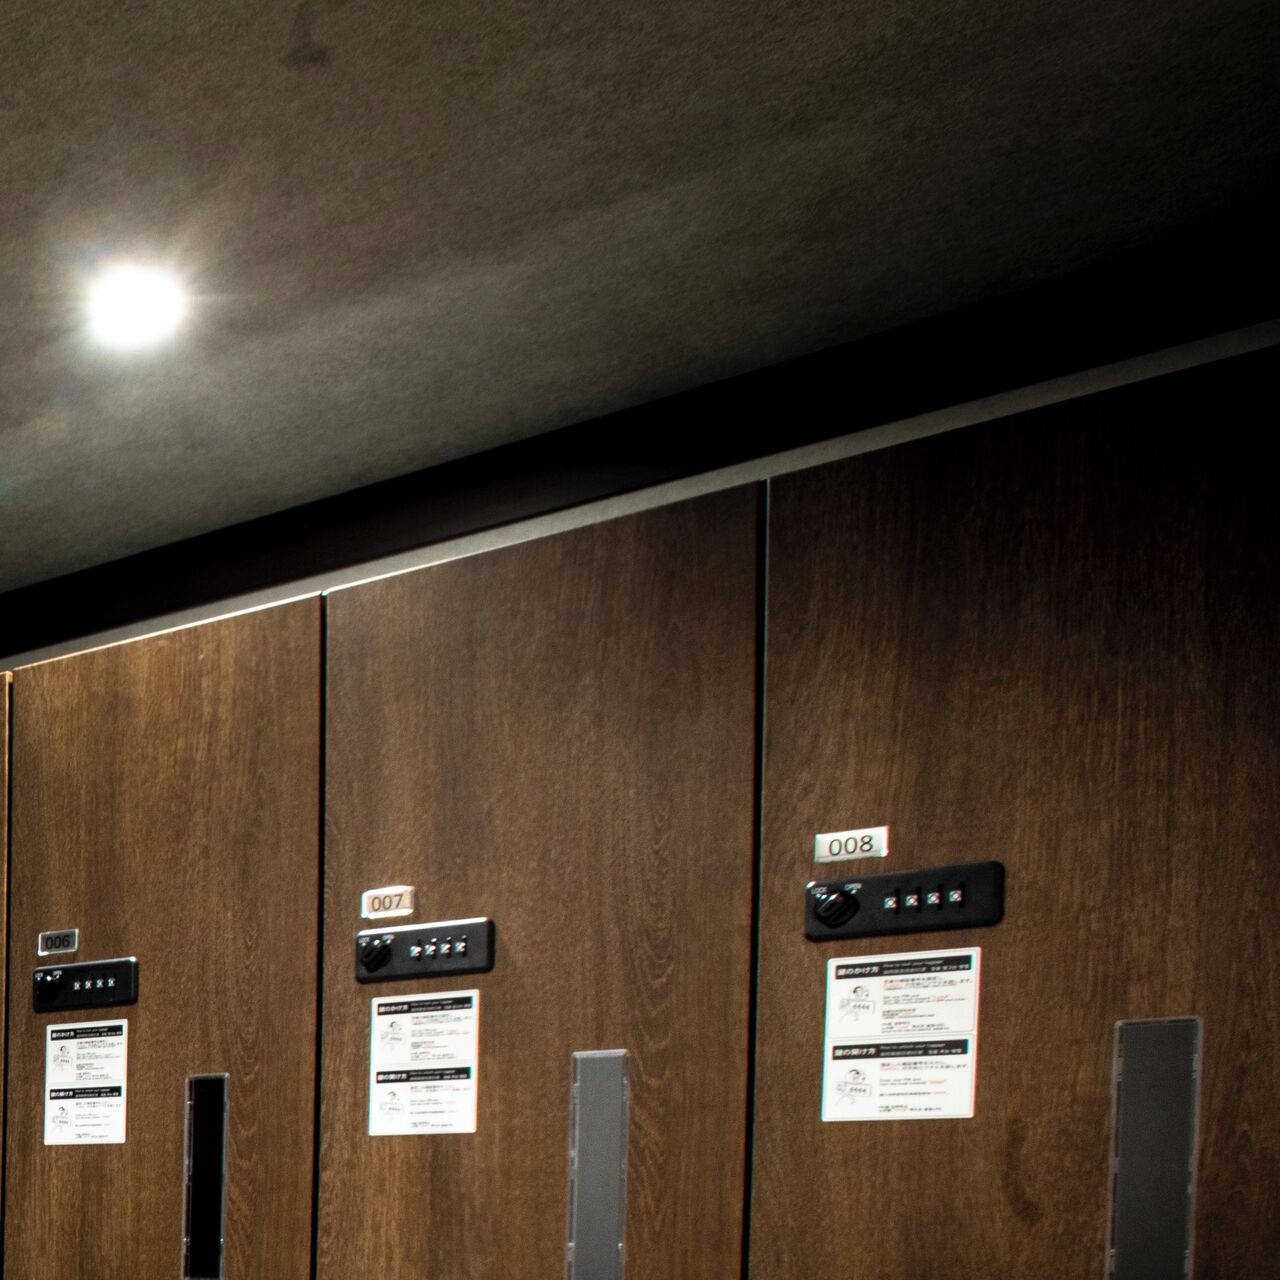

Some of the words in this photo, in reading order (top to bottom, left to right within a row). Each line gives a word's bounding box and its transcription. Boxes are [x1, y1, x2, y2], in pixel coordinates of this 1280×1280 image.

[828, 835, 874, 857] 008
[371, 894, 404, 912] 007
[45, 935, 70, 950] 006
